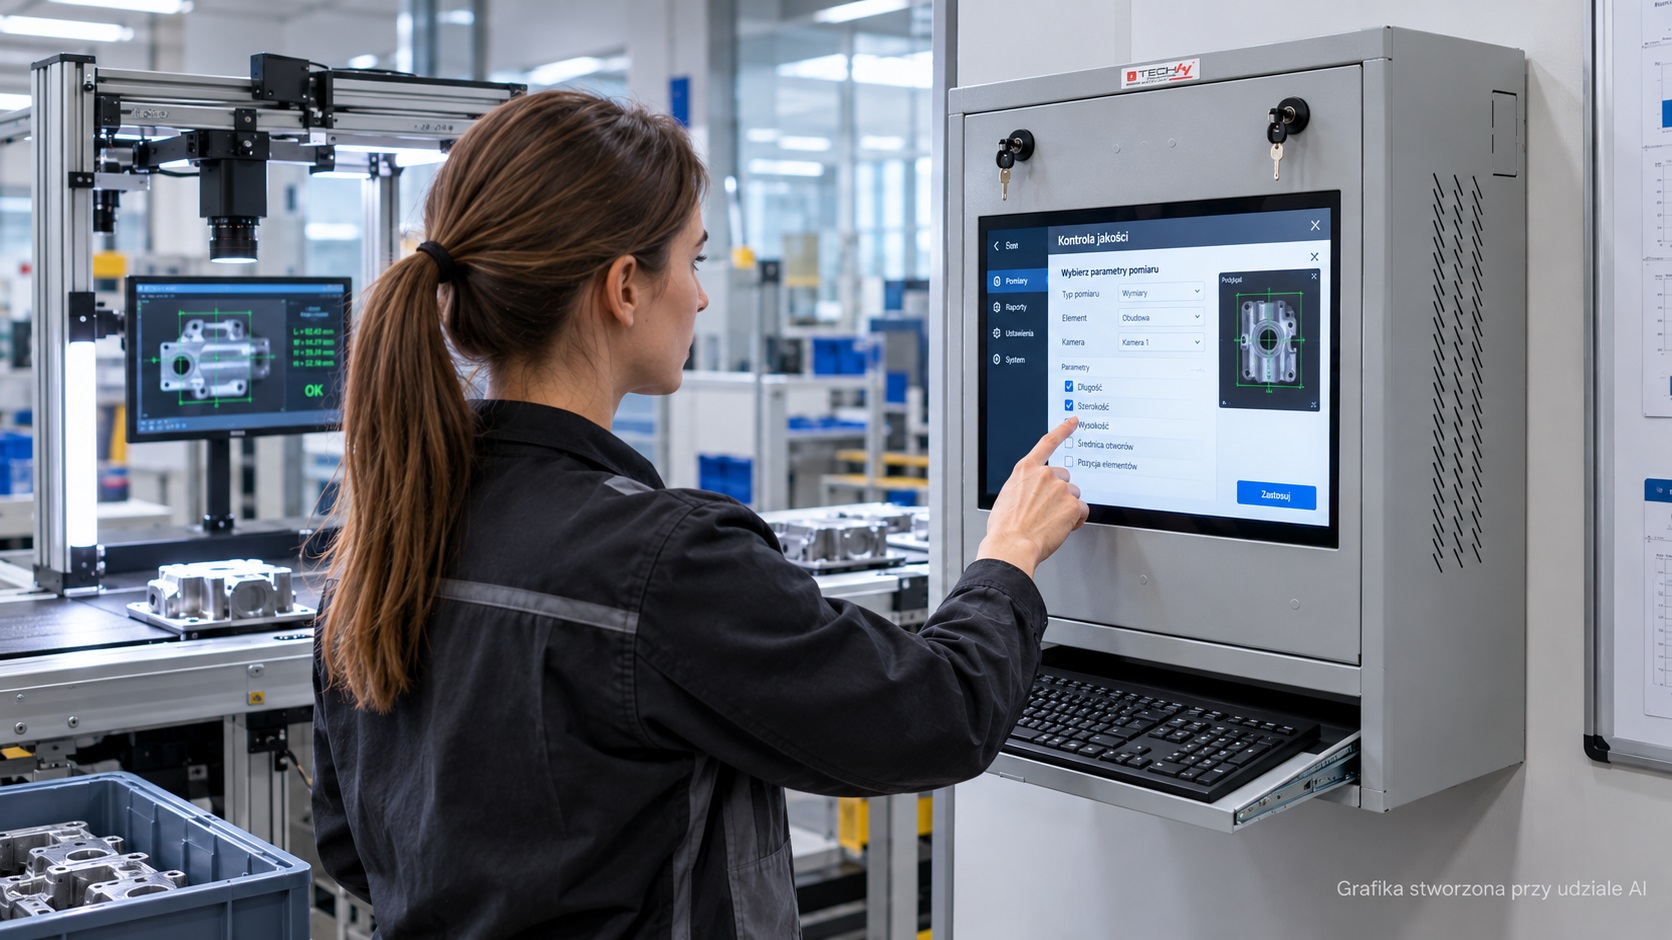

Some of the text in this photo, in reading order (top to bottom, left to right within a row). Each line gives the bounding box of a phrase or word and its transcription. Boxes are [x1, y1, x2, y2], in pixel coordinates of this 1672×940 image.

[1058, 231, 1129, 246] Kontrola jakości
[1061, 265, 1159, 279] Wybierz parametry pomiaru
[1005, 277, 1028, 286] Pomiary
[1062, 289, 1100, 300] Typ pomiaru
[1062, 314, 1088, 322] Element
[1062, 338, 1085, 346] Kamera
[1005, 356, 1026, 365] System
[1061, 363, 1090, 373] Parametry
[304, 384, 324, 397] OK
[1077, 402, 1110, 411] Szerokość
[1077, 439, 1134, 451] Średnica otworów
[1077, 459, 1101, 469] Pozycja
[1261, 489, 1291, 502] Zastosuj
